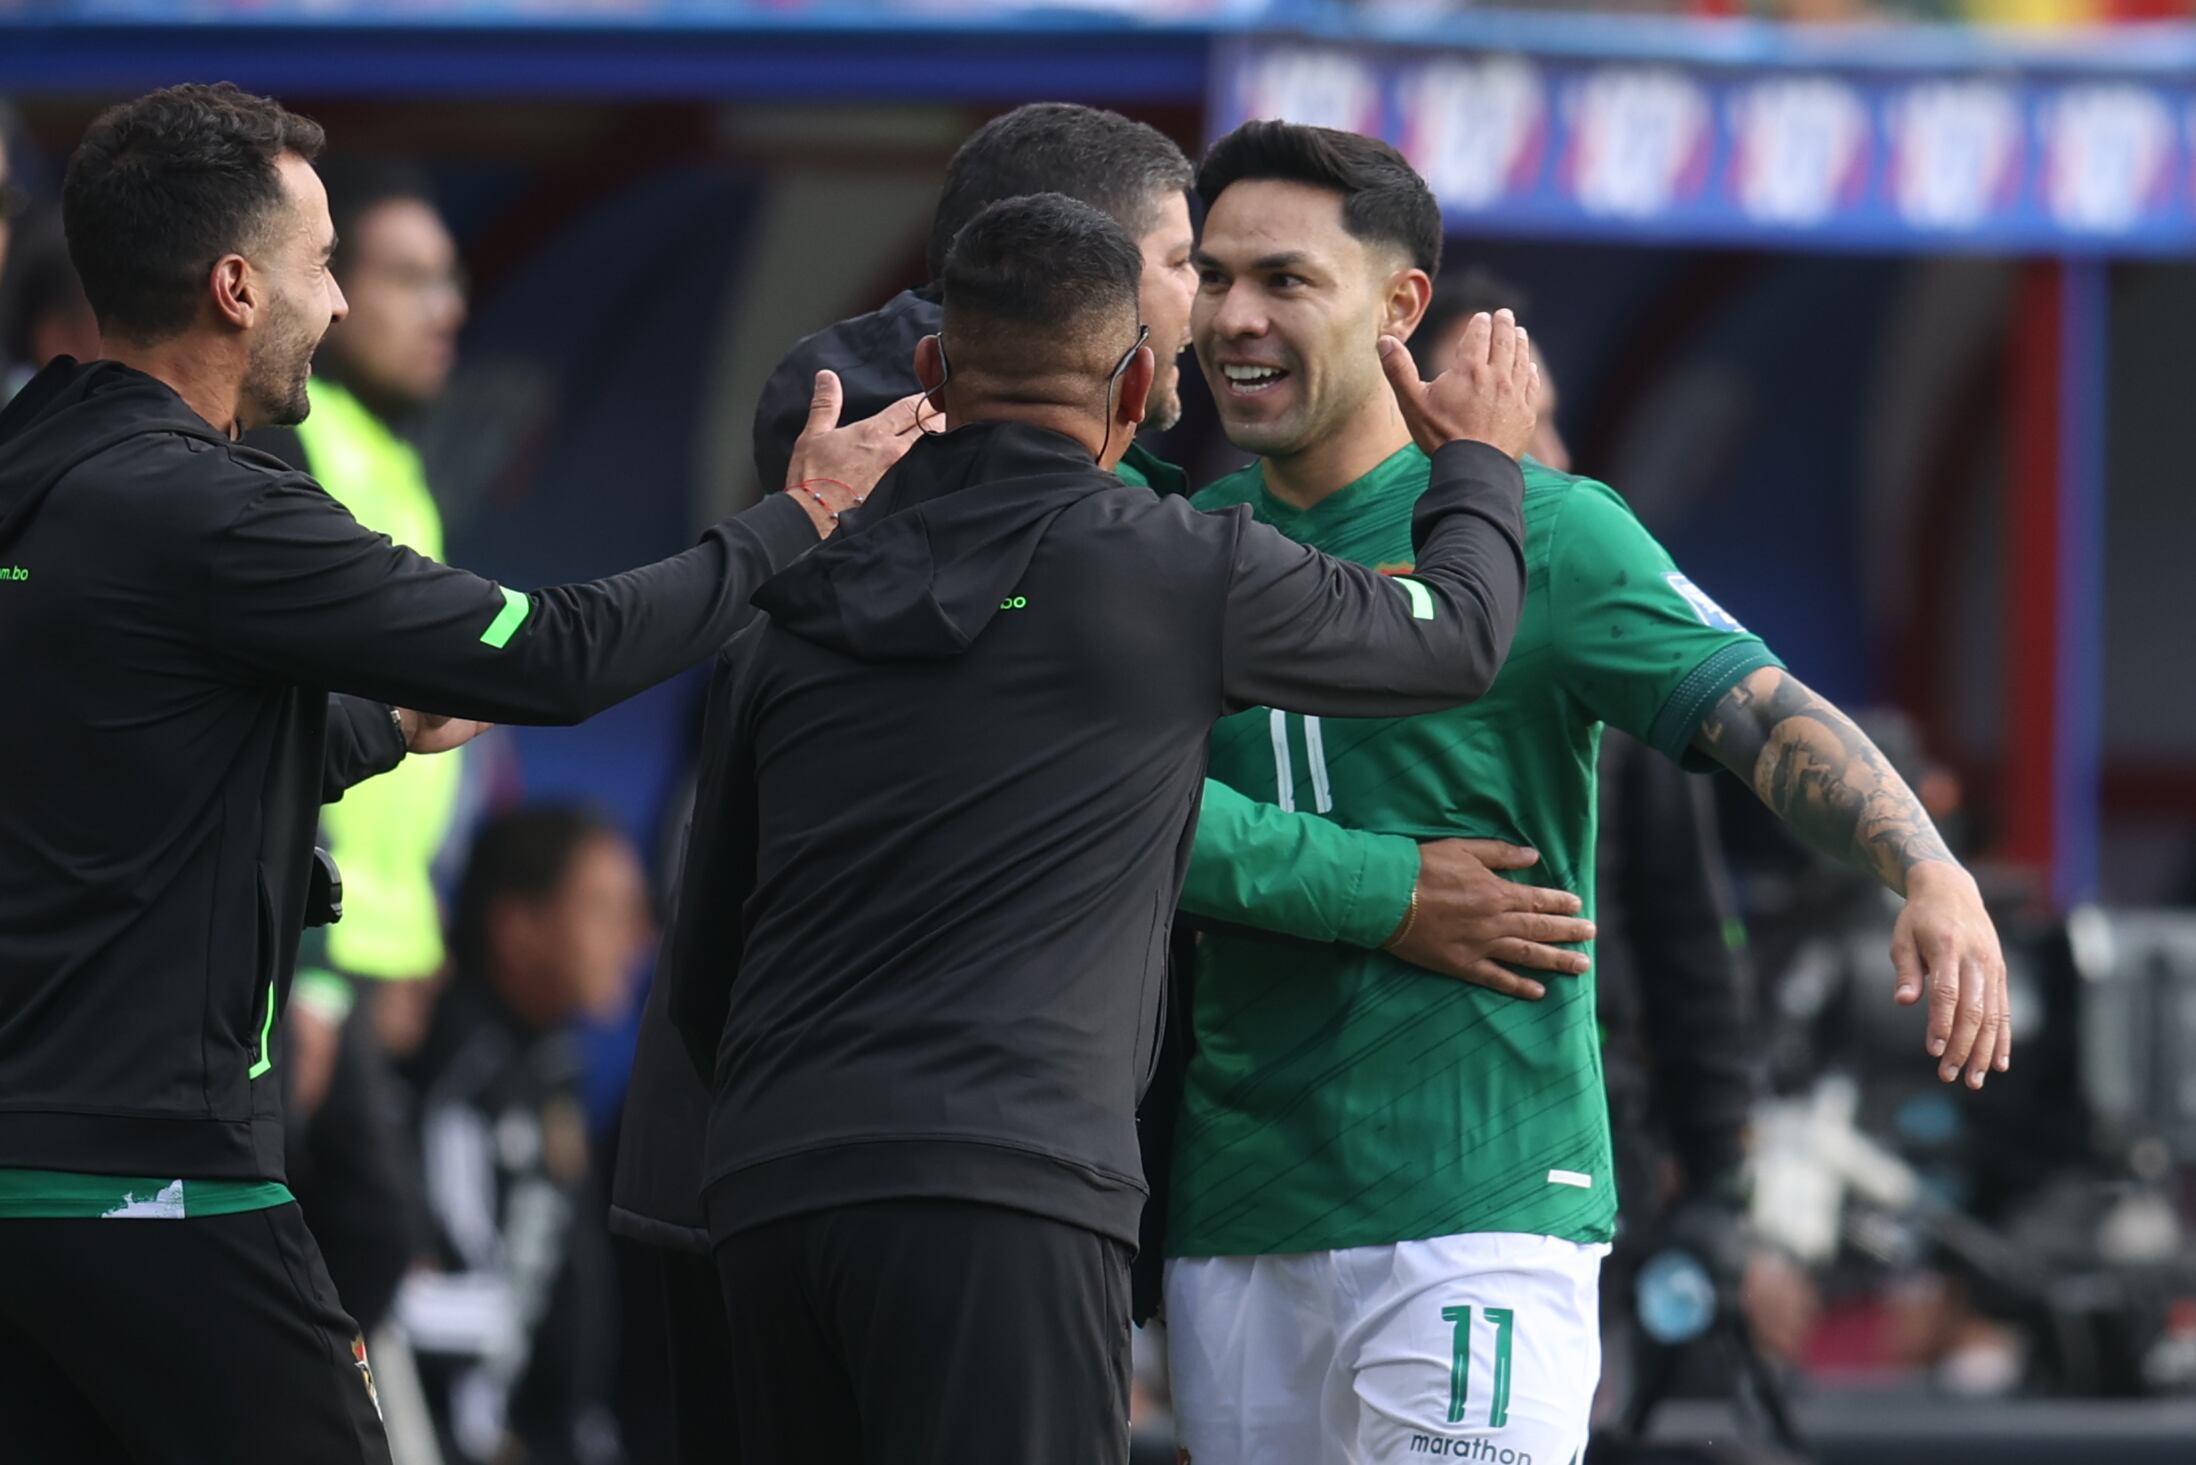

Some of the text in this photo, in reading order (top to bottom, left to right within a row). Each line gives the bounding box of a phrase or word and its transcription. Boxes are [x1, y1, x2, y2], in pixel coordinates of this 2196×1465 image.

[0, 564, 29, 581] m.bo
[1441, 1305, 1514, 1428] 11
[1410, 1433, 1532, 1465] marathon
